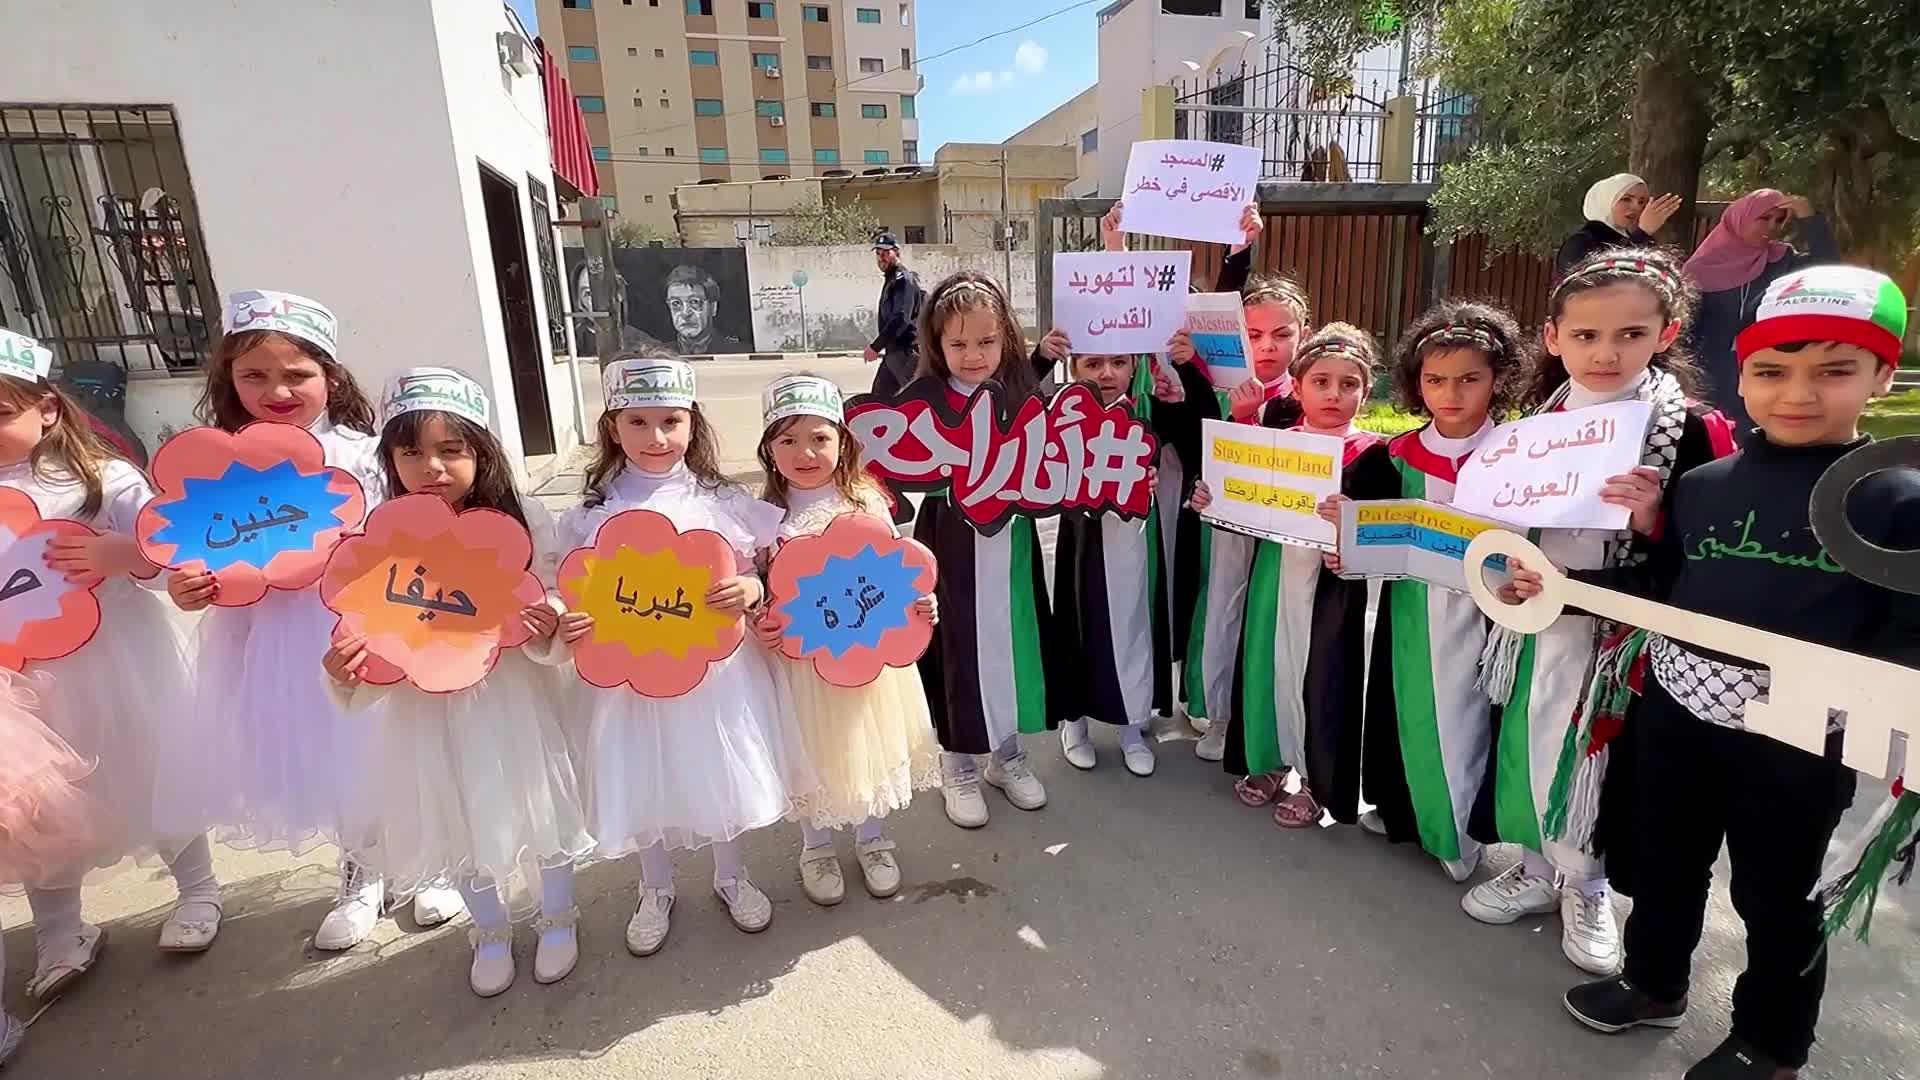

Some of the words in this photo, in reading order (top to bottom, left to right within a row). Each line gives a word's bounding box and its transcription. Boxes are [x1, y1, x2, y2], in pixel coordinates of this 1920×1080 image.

[1160, 152, 1225, 172] #المسجد
[1130, 176, 1161, 194] خطر
[1165, 177, 1188, 200] في
[1068, 264, 1135, 295] لتهويد
[1087, 306, 1152, 336] القدس
[1480, 428, 1519, 468] في
[1527, 418, 1615, 459] القدس
[1214, 440, 1241, 464] Stay
[1248, 447, 1261, 465] in
[1266, 456, 1291, 470] our
[1297, 456, 1334, 477] land
[1262, 489, 1278, 506] في
[1492, 471, 1579, 508] العيون
[206, 495, 309, 549] جنين
[1358, 506, 1452, 531] Palestine
[385, 562, 478, 622] حيفا
[615, 575, 694, 621] طبريا
[815, 575, 886, 630] غزة
